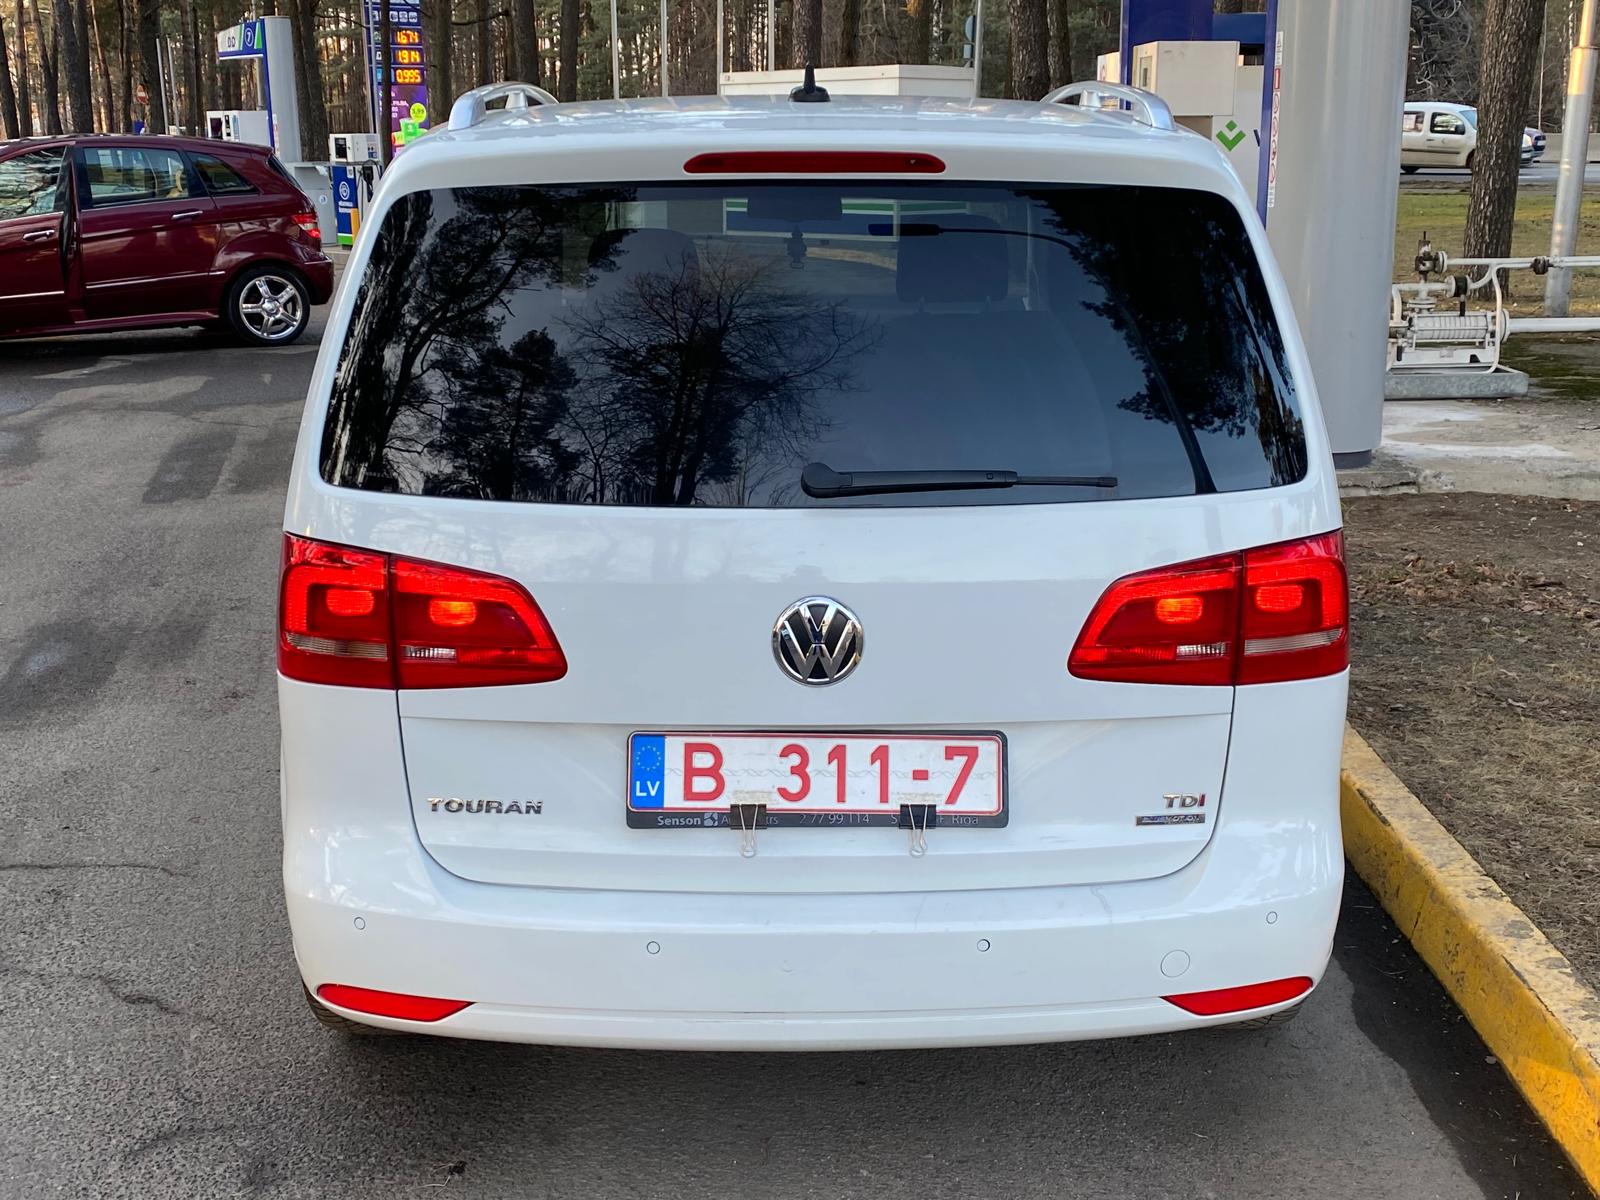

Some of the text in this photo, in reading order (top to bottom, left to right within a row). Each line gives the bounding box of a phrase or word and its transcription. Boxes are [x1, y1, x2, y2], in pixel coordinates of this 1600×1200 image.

[683, 742, 980, 805] B 311-7
[635, 780, 660, 797] LV
[427, 797, 543, 815] TOURAN
[1163, 793, 1206, 808] TDI
[657, 815, 701, 826] Senson
